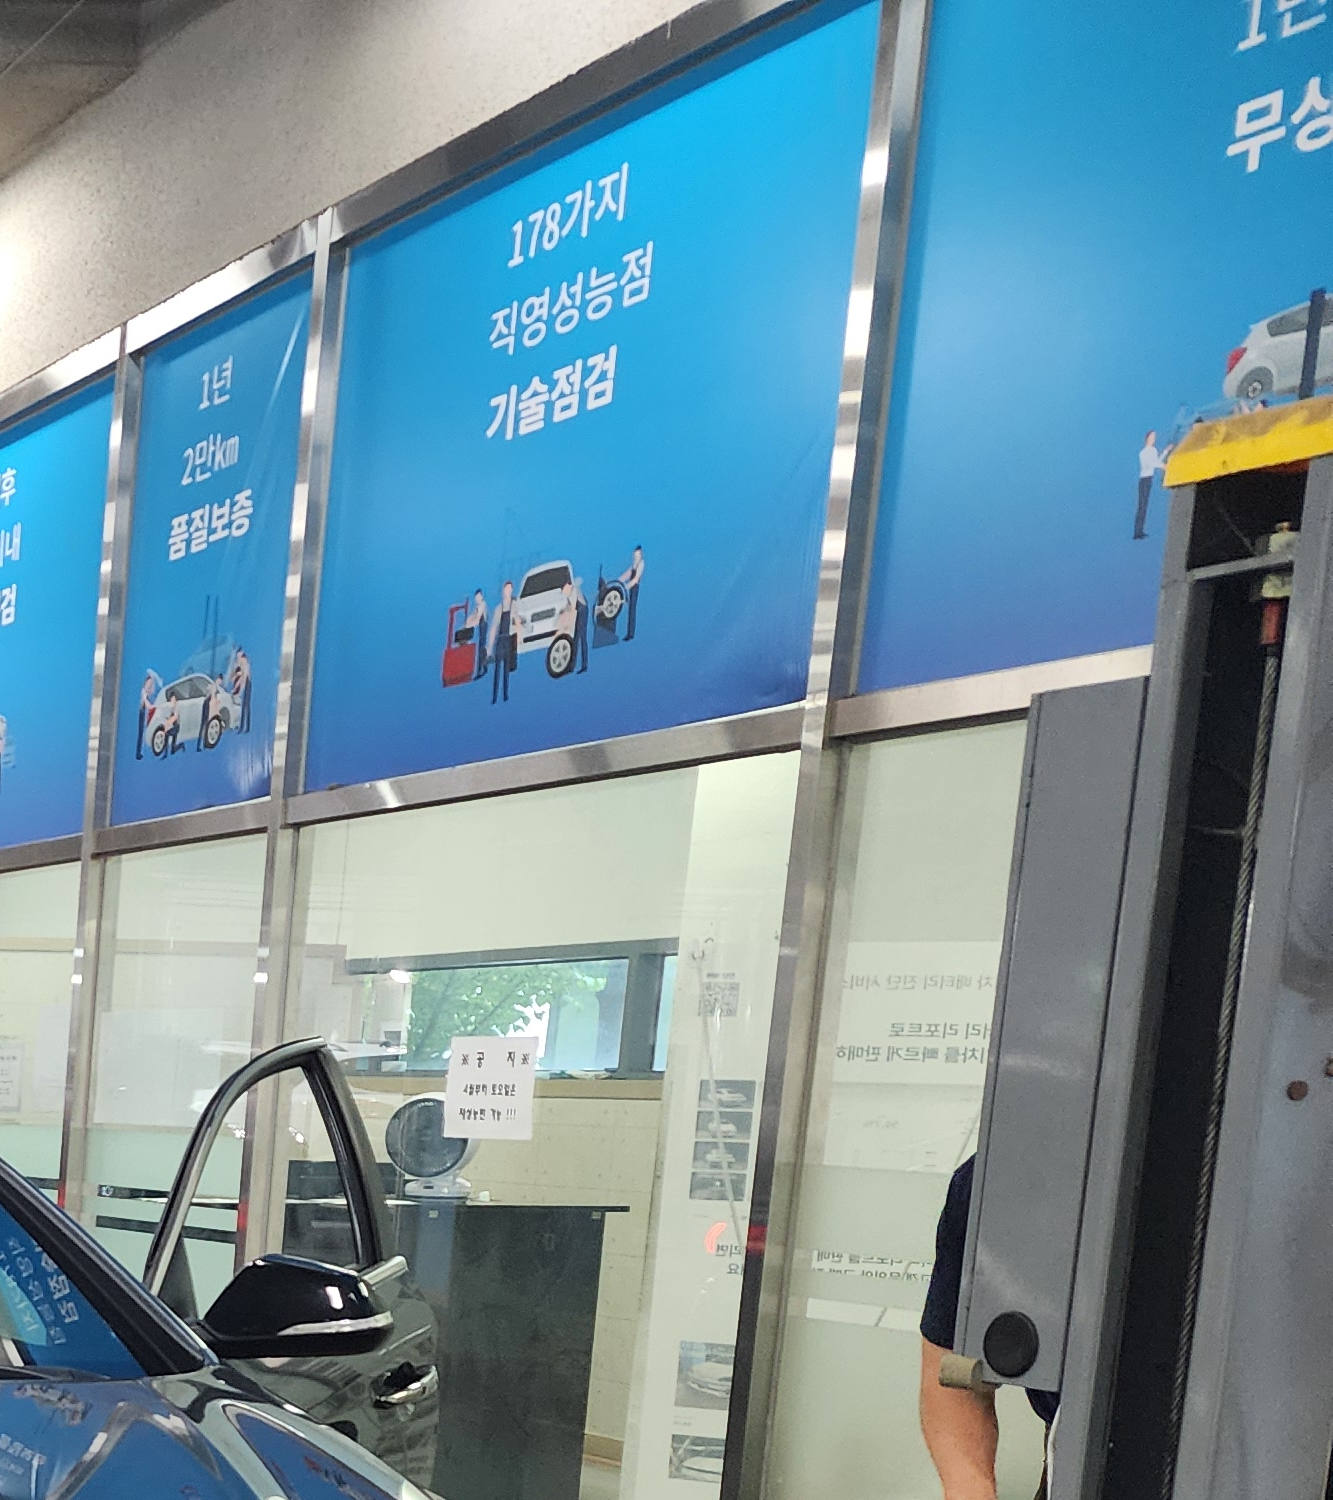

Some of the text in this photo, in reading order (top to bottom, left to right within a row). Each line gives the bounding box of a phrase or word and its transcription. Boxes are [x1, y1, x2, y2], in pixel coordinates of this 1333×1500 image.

[507, 161, 629, 268] 178가지
[489, 240, 654, 355] 직영성능점
[199, 355, 233, 410] 1년
[486, 344, 618, 441] 기술점검
[181, 433, 240, 486] 2만km
[168, 488, 254, 562] 품질보증
